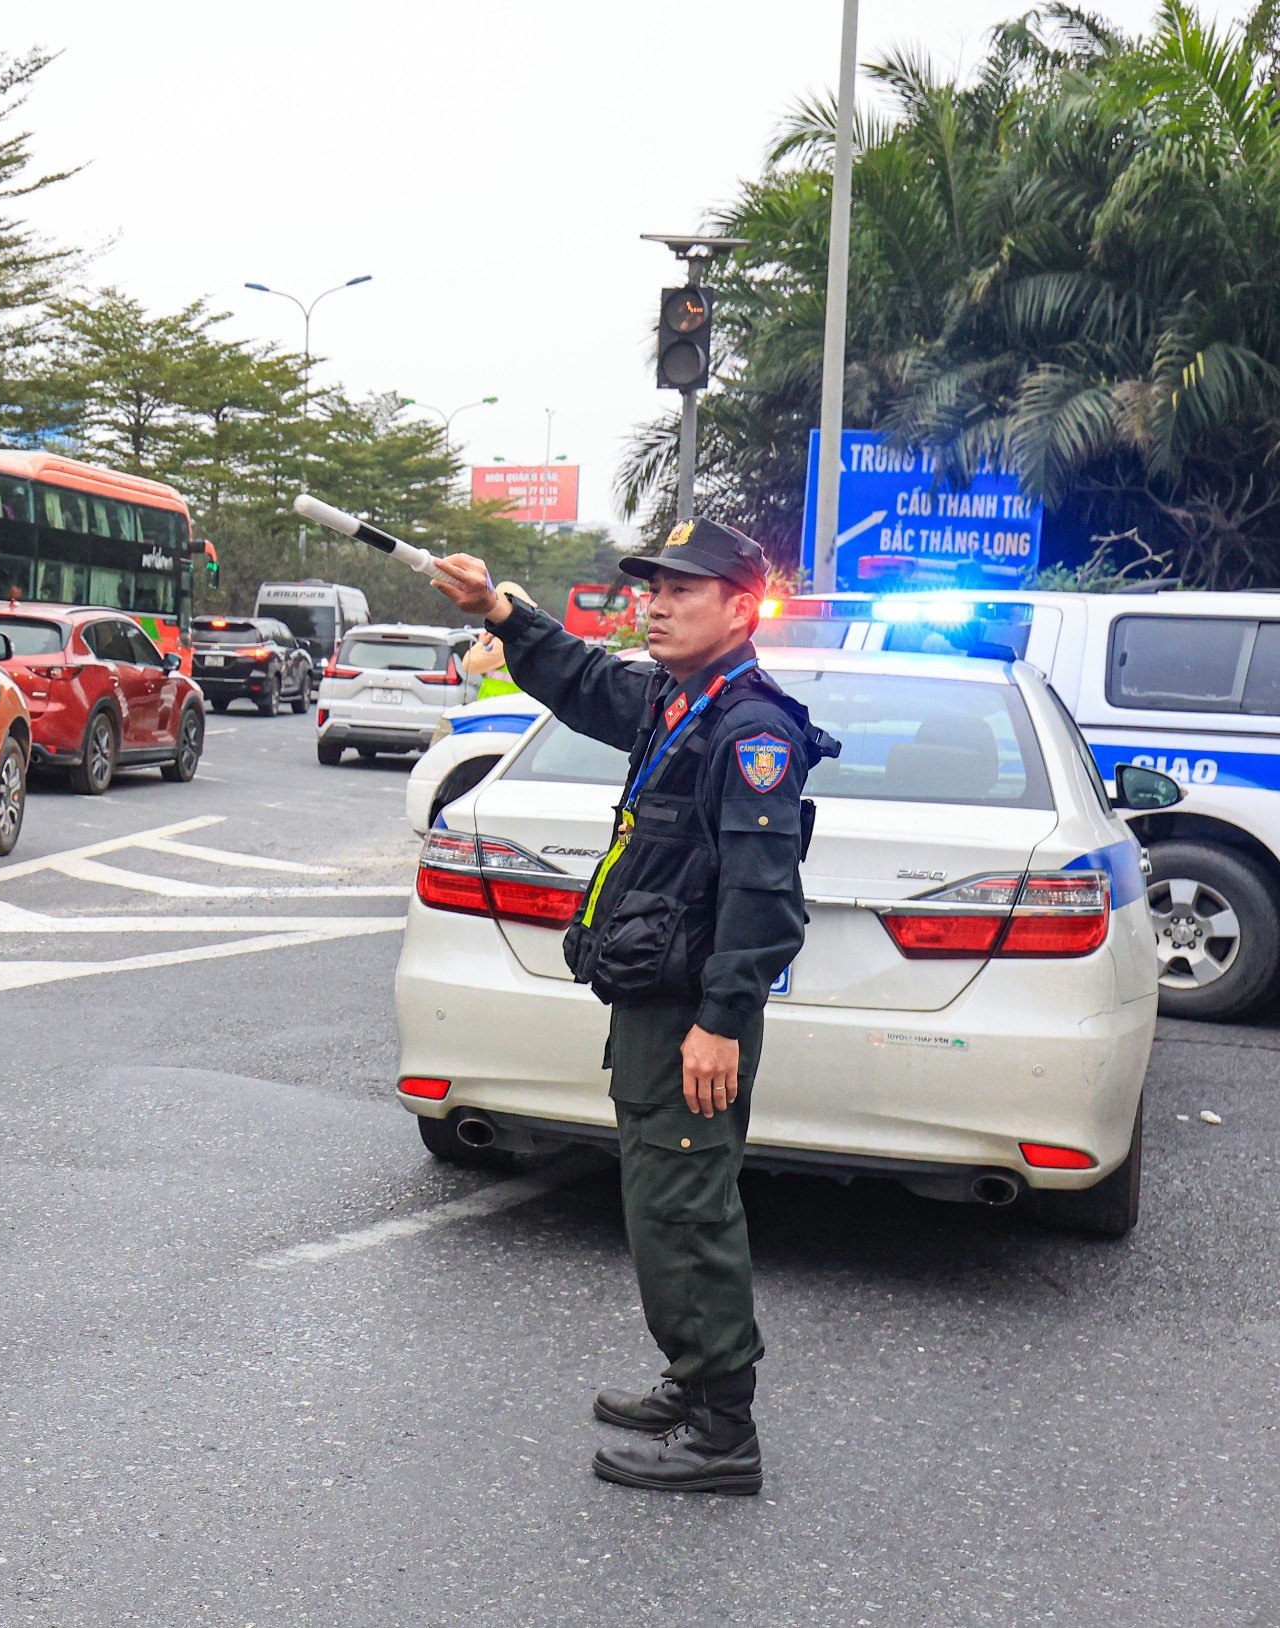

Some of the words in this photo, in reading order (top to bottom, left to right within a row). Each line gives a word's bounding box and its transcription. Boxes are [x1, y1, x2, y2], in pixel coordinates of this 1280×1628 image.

[937, 492, 998, 519] THANH
[879, 519, 915, 552] BẮC
[919, 525, 980, 554] THĂNG
[982, 531, 1031, 556] LONG
